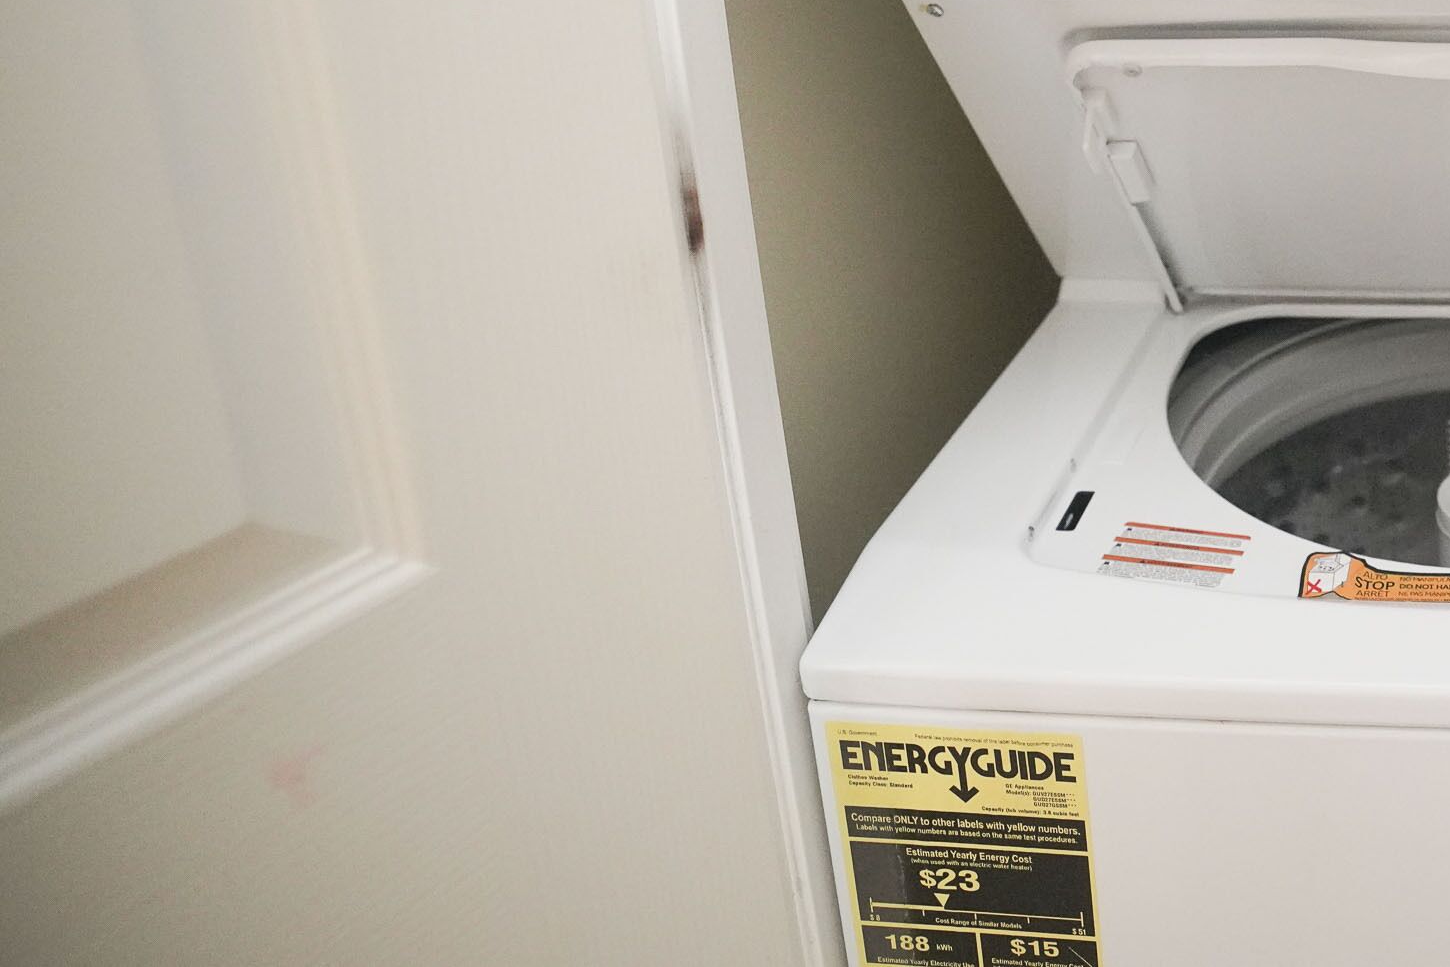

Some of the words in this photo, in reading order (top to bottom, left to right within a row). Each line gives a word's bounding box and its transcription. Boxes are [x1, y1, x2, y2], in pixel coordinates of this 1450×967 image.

[1354, 576, 1395, 590] STOP
[839, 739, 1077, 784] ENERGYGUIDE
[851, 812, 891, 824] Compare
[893, 814, 919, 825] ONLY
[920, 817, 930, 826] to
[931, 818, 955, 827] other
[957, 818, 984, 829] labels
[985, 821, 1005, 830] with
[1006, 822, 1036, 833] yellow
[1038, 823, 1081, 836] numbers.
[856, 823, 878, 831] Labels
[879, 824, 894, 832] with
[894, 825, 917, 834] yellow
[917, 826, 946, 835] numbers
[960, 829, 980, 837] based
[992, 831, 1003, 839] the
[1023, 833, 1037, 841] test
[1037, 835, 1078, 844] procedures.
[905, 847, 949, 859] Estimated
[950, 850, 977, 862] Yearly
[979, 851, 1010, 864] Energy
[1011, 854, 1033, 864] Cost
[919, 868, 980, 892] $23
[884, 934, 930, 952] 188
[1010, 938, 1060, 957] $15
